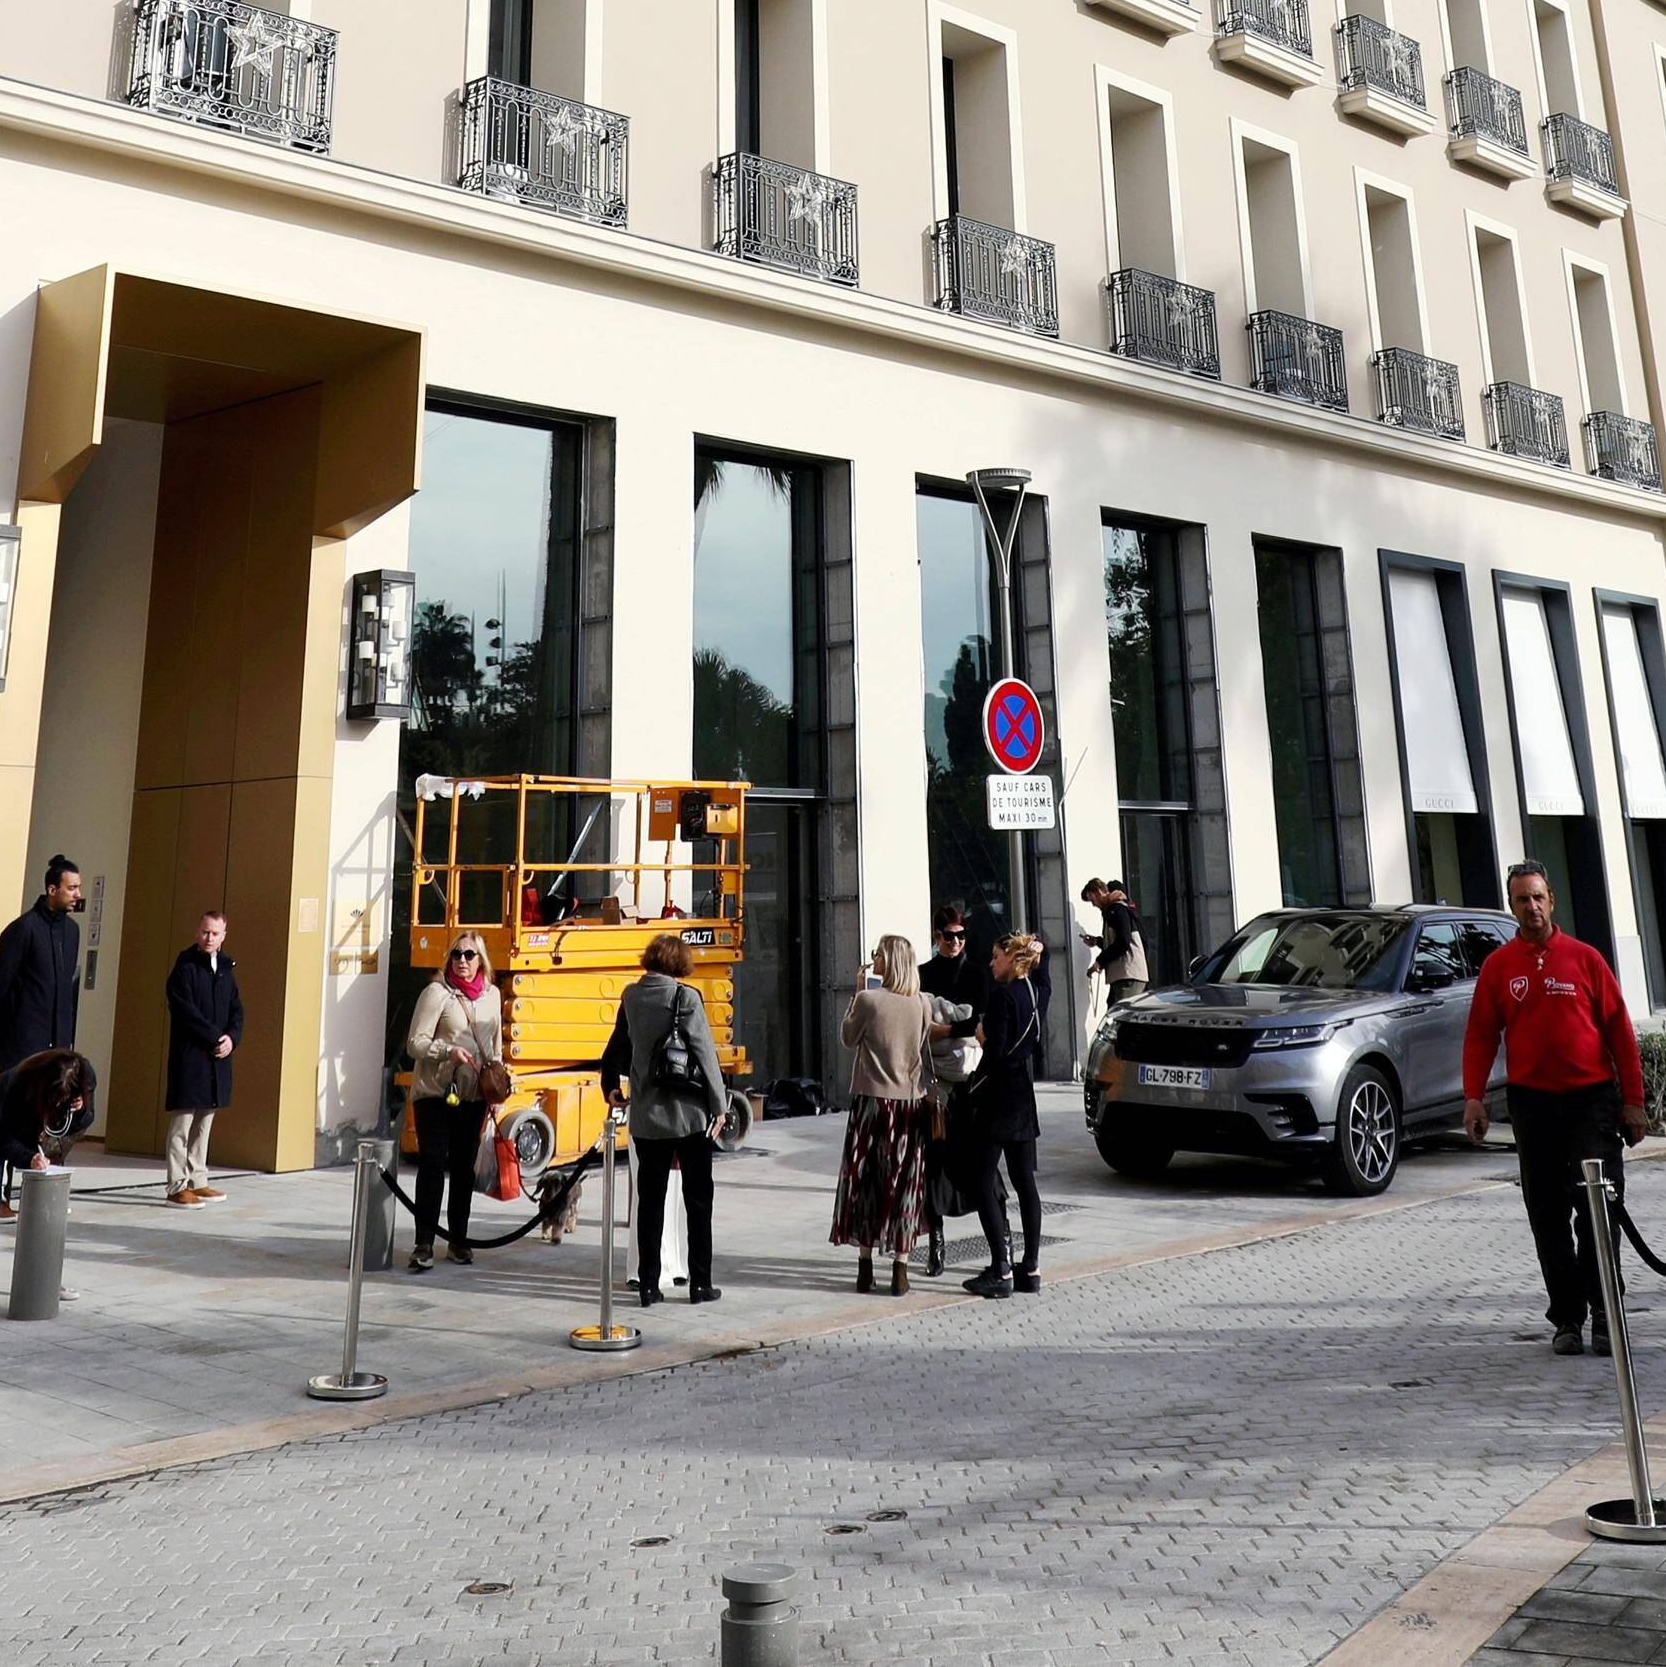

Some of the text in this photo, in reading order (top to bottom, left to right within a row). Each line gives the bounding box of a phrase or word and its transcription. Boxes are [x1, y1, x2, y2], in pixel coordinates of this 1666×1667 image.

[996, 782, 1046, 792] SAUF CARS
[992, 797, 1052, 808] DE TOURISME
[1425, 797, 1454, 810] GUCCI
[999, 813, 1021, 823] MAXI
[1025, 813, 1037, 823] 30
